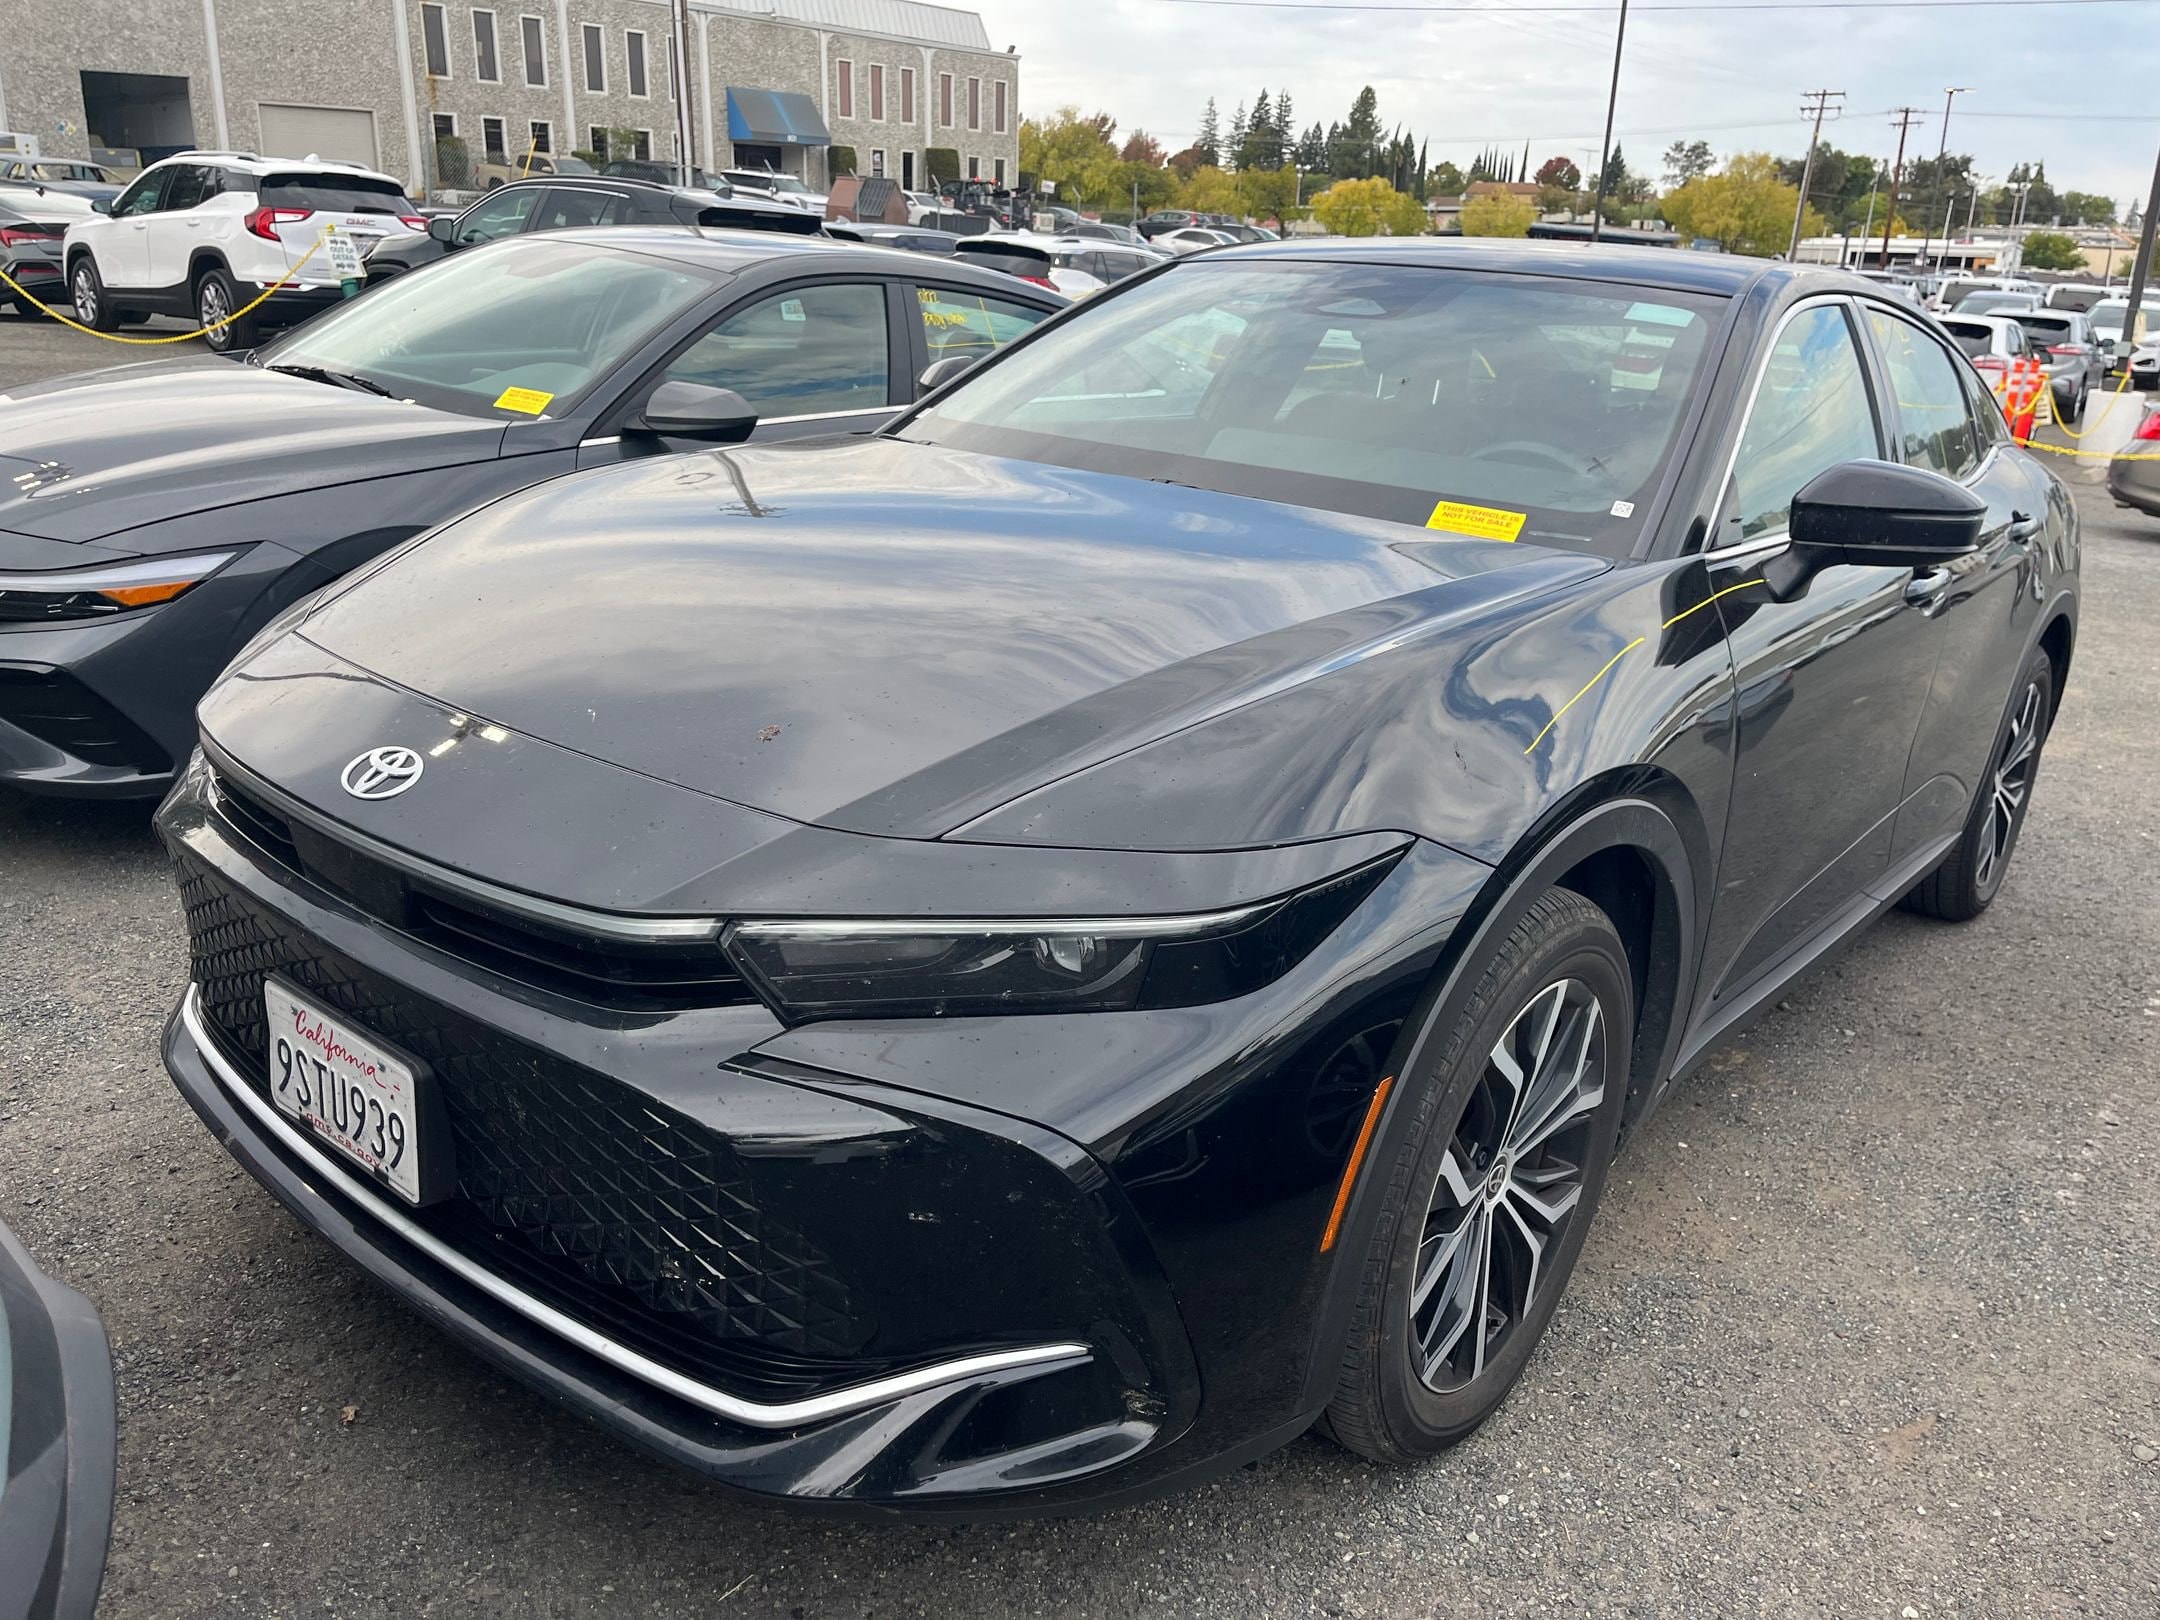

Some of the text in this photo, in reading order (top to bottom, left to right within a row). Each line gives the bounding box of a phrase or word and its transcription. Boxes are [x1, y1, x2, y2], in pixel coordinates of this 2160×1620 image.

[346, 218, 376, 226] GMC
[1442, 505, 1463, 513] THIS
[1466, 508, 1507, 520] VEHICLE
[1442, 511, 1513, 528] NOT FOR SALE
[295, 1009, 387, 1089] California
[277, 1038, 404, 1169] 9STU939
